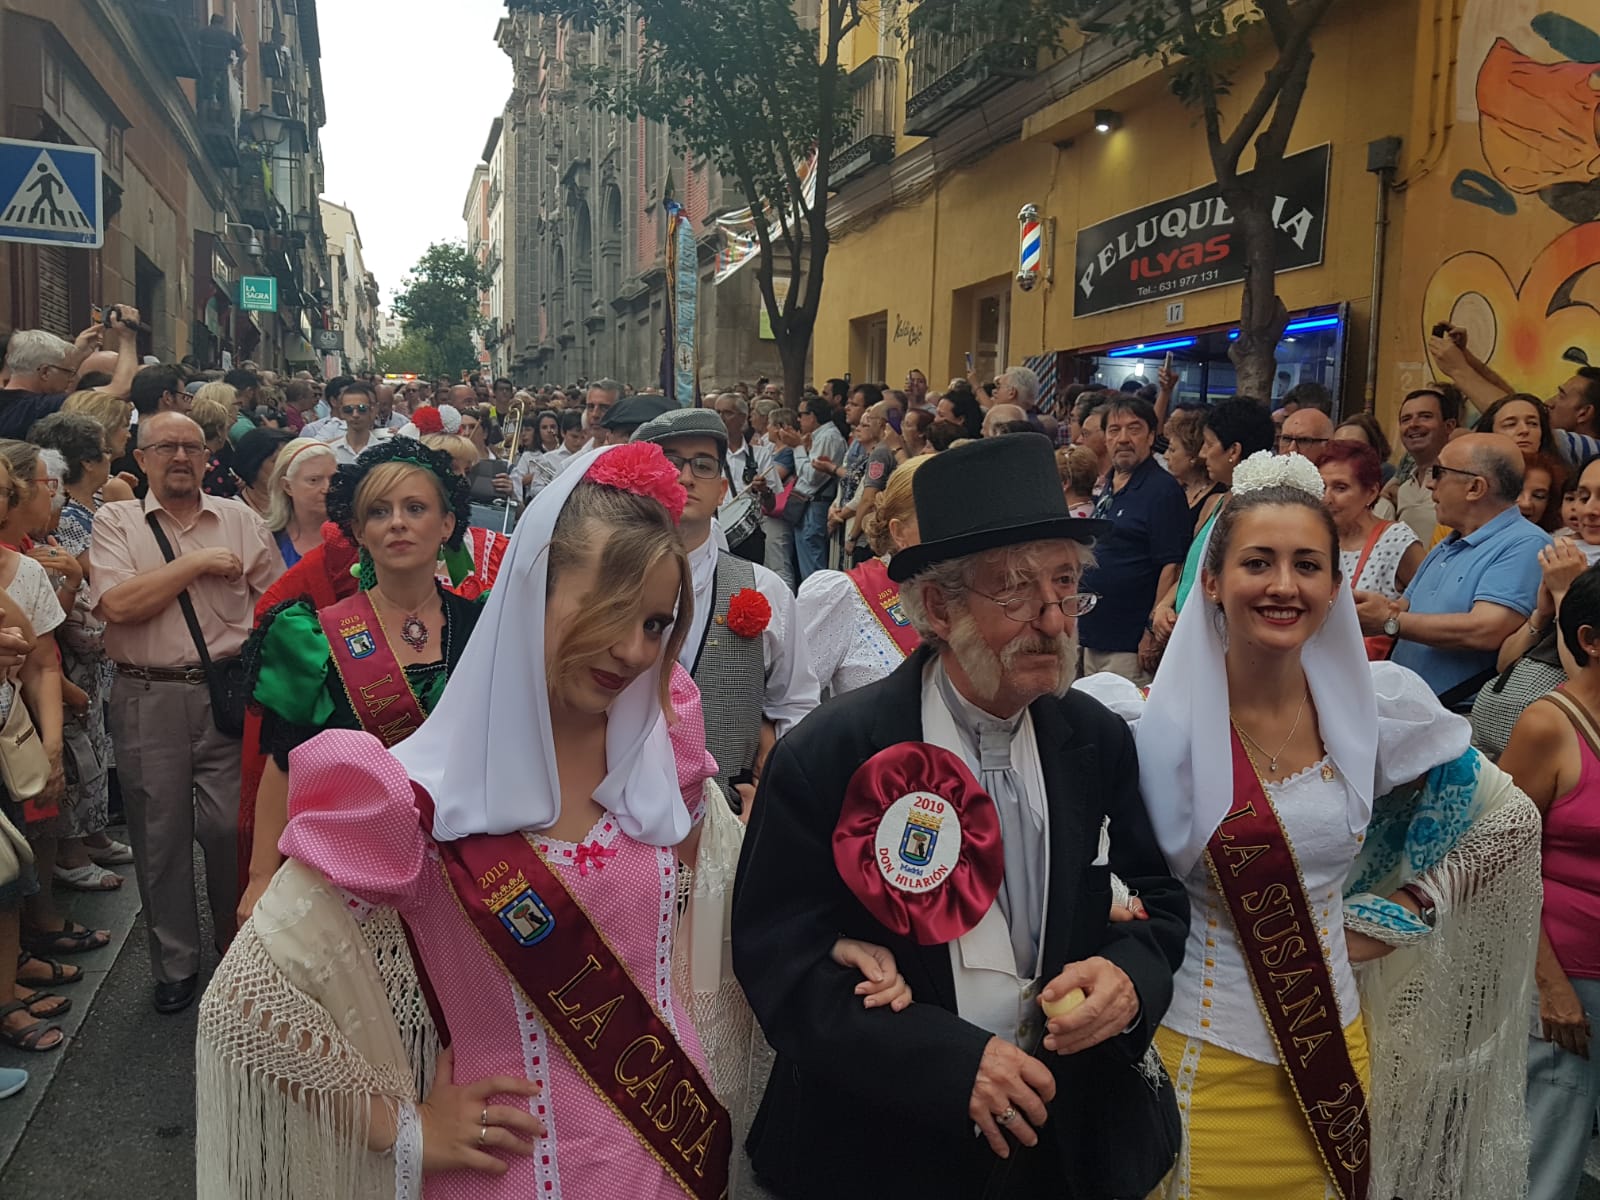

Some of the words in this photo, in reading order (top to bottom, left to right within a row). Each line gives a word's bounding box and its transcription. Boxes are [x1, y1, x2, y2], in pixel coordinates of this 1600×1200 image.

[1079, 196, 1314, 298] PELUQUEIA
[1159, 280, 1177, 292] 631
[1179, 274, 1198, 287] 977
[1201, 269, 1219, 281] 131
[1169, 304, 1182, 321] 17
[340, 615, 360, 626] 2019
[360, 673, 401, 718] LA
[913, 796, 945, 814] 2019
[1216, 801, 1271, 878] LA
[477, 860, 511, 889] 2019
[879, 848, 895, 874] DON
[895, 864, 949, 888] HILARIÓN
[899, 863, 924, 876] Madrid
[1241, 883, 1332, 1069] SUSANA
[548, 954, 625, 1050] LA
[614, 1034, 718, 1178] CASTA
[1316, 1082, 1369, 1173] 2019
